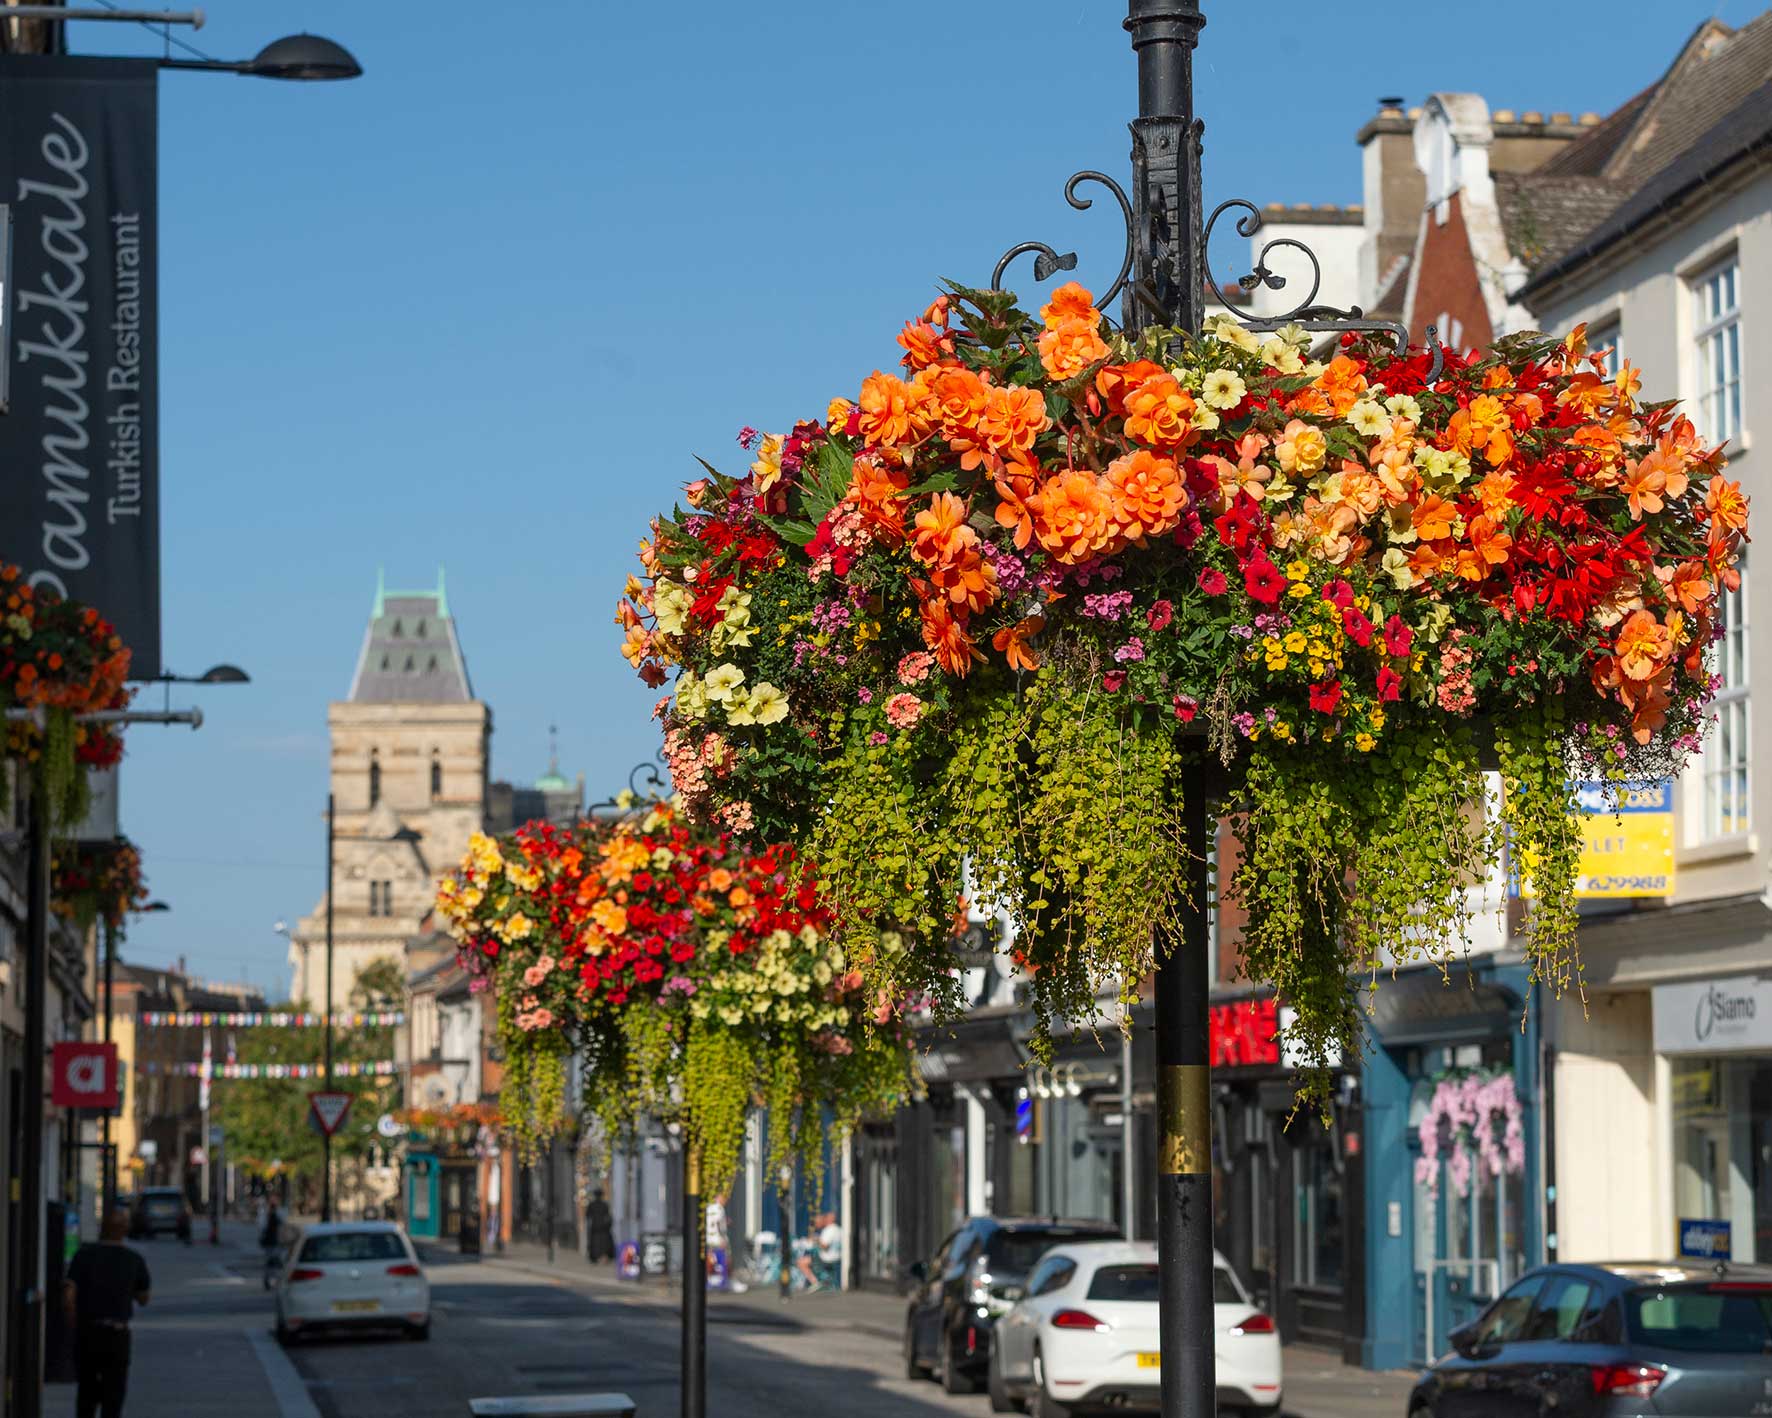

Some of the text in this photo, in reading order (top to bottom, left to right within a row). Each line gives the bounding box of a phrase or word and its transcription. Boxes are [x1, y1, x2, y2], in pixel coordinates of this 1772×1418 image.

[107, 211, 142, 525] Turkish Restaurant
[1592, 836, 1625, 854] LET
